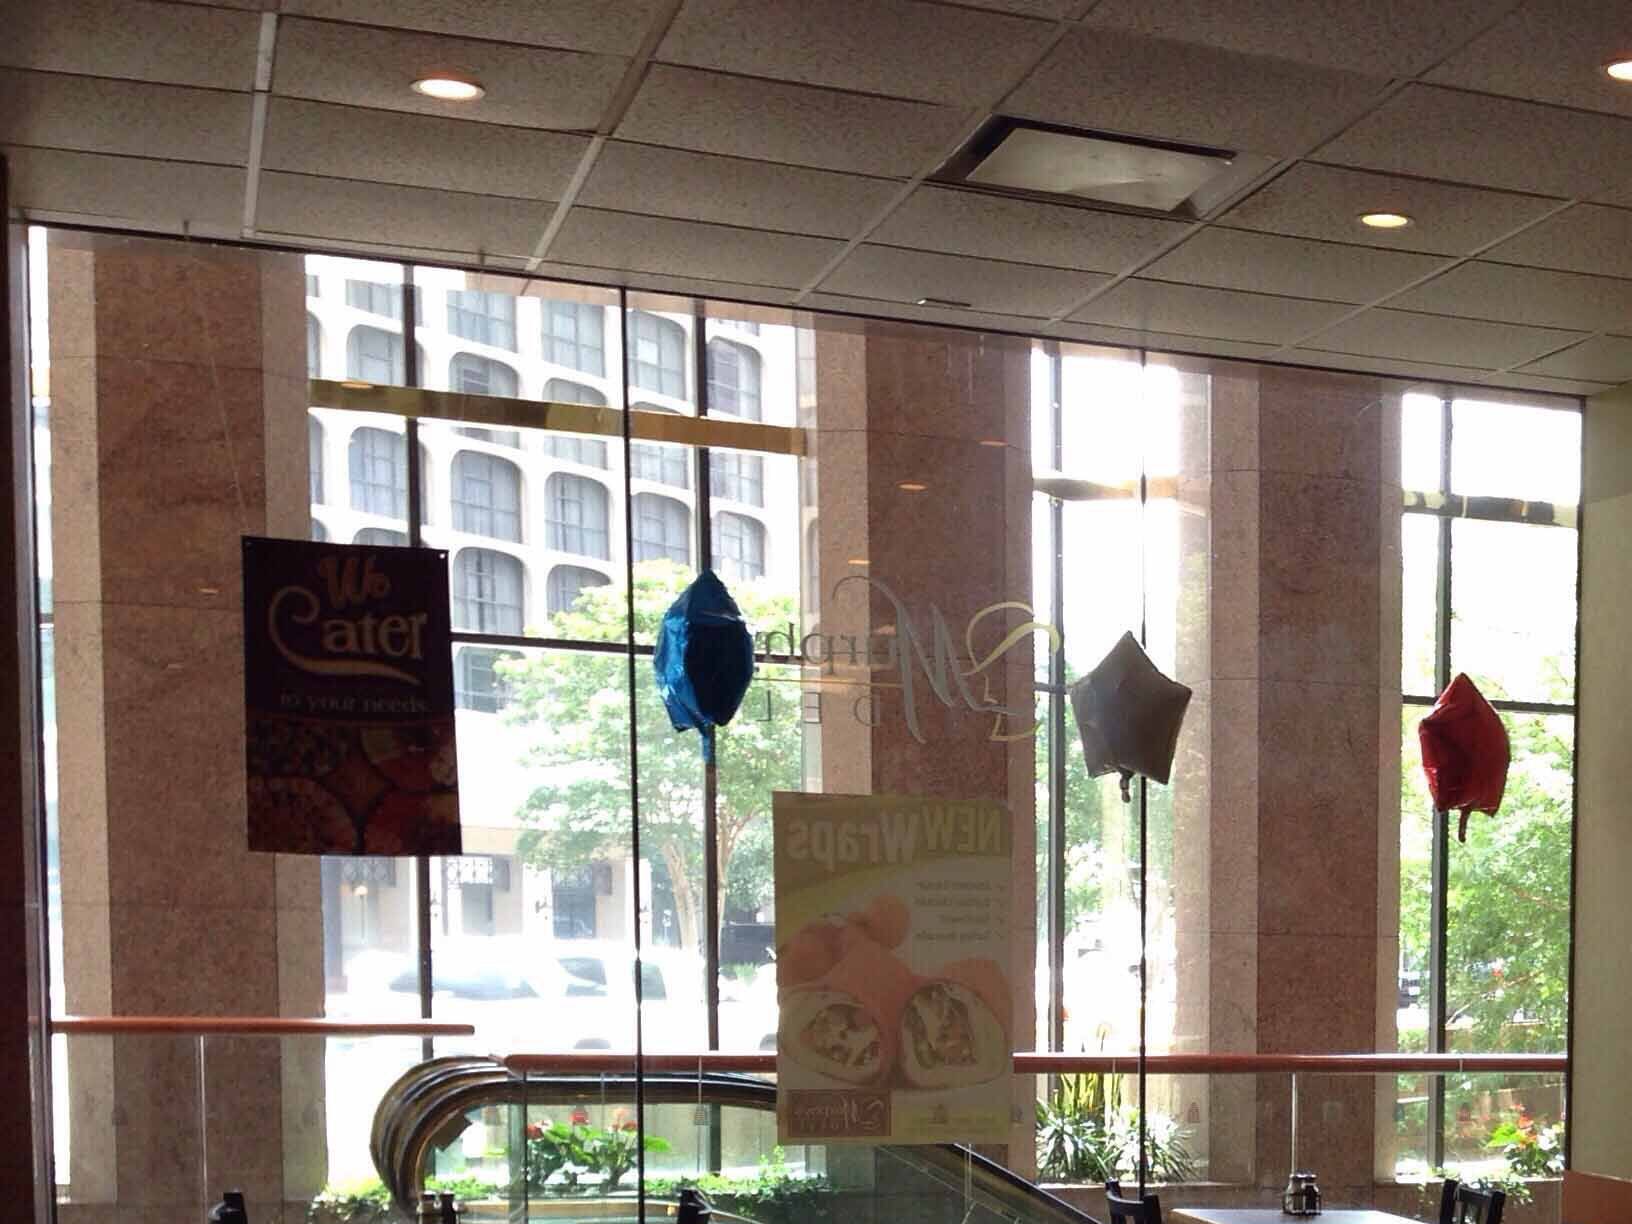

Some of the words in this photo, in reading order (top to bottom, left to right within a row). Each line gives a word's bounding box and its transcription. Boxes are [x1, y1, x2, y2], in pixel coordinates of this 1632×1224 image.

[317, 554, 391, 607] We
[269, 586, 428, 685] Cater
[306, 694, 353, 713] your
